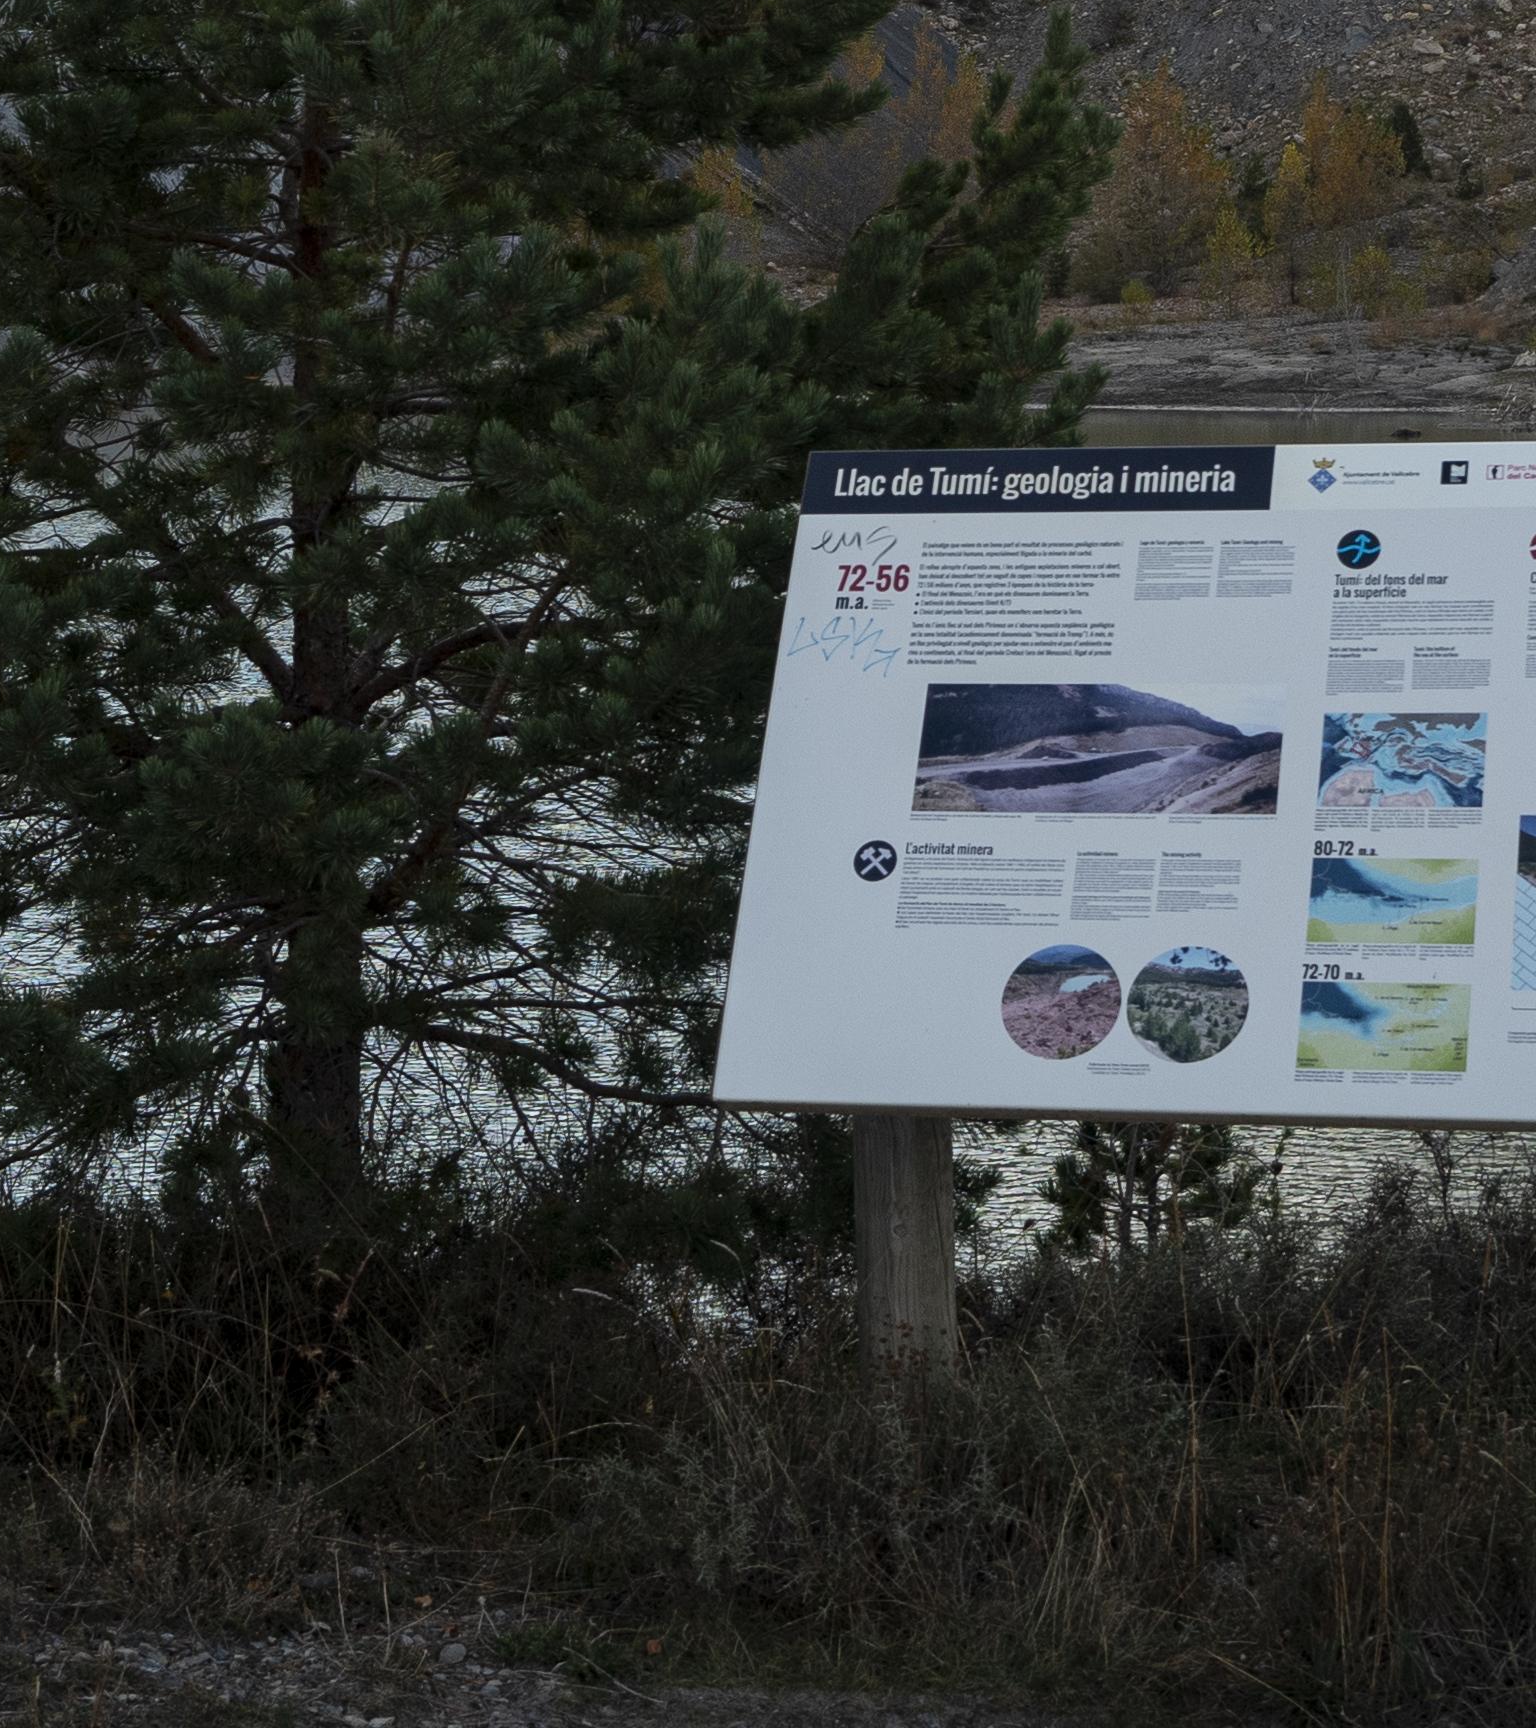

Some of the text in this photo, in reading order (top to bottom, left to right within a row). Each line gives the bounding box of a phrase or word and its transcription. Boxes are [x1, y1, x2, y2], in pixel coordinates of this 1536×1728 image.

[1507, 464, 1526, 472] Parc
[834, 464, 1235, 500] Llac de Tumí: geologia i mineria
[837, 564, 910, 593] 72-56
[1335, 573, 1449, 586] Tumí: del fons del mar
[1333, 586, 1407, 600] a la superfície
[835, 596, 869, 610] m.a.
[905, 841, 994, 855] L'activitat minera
[1314, 840, 1354, 856] 80-72
[1302, 964, 1341, 980] 72-70
